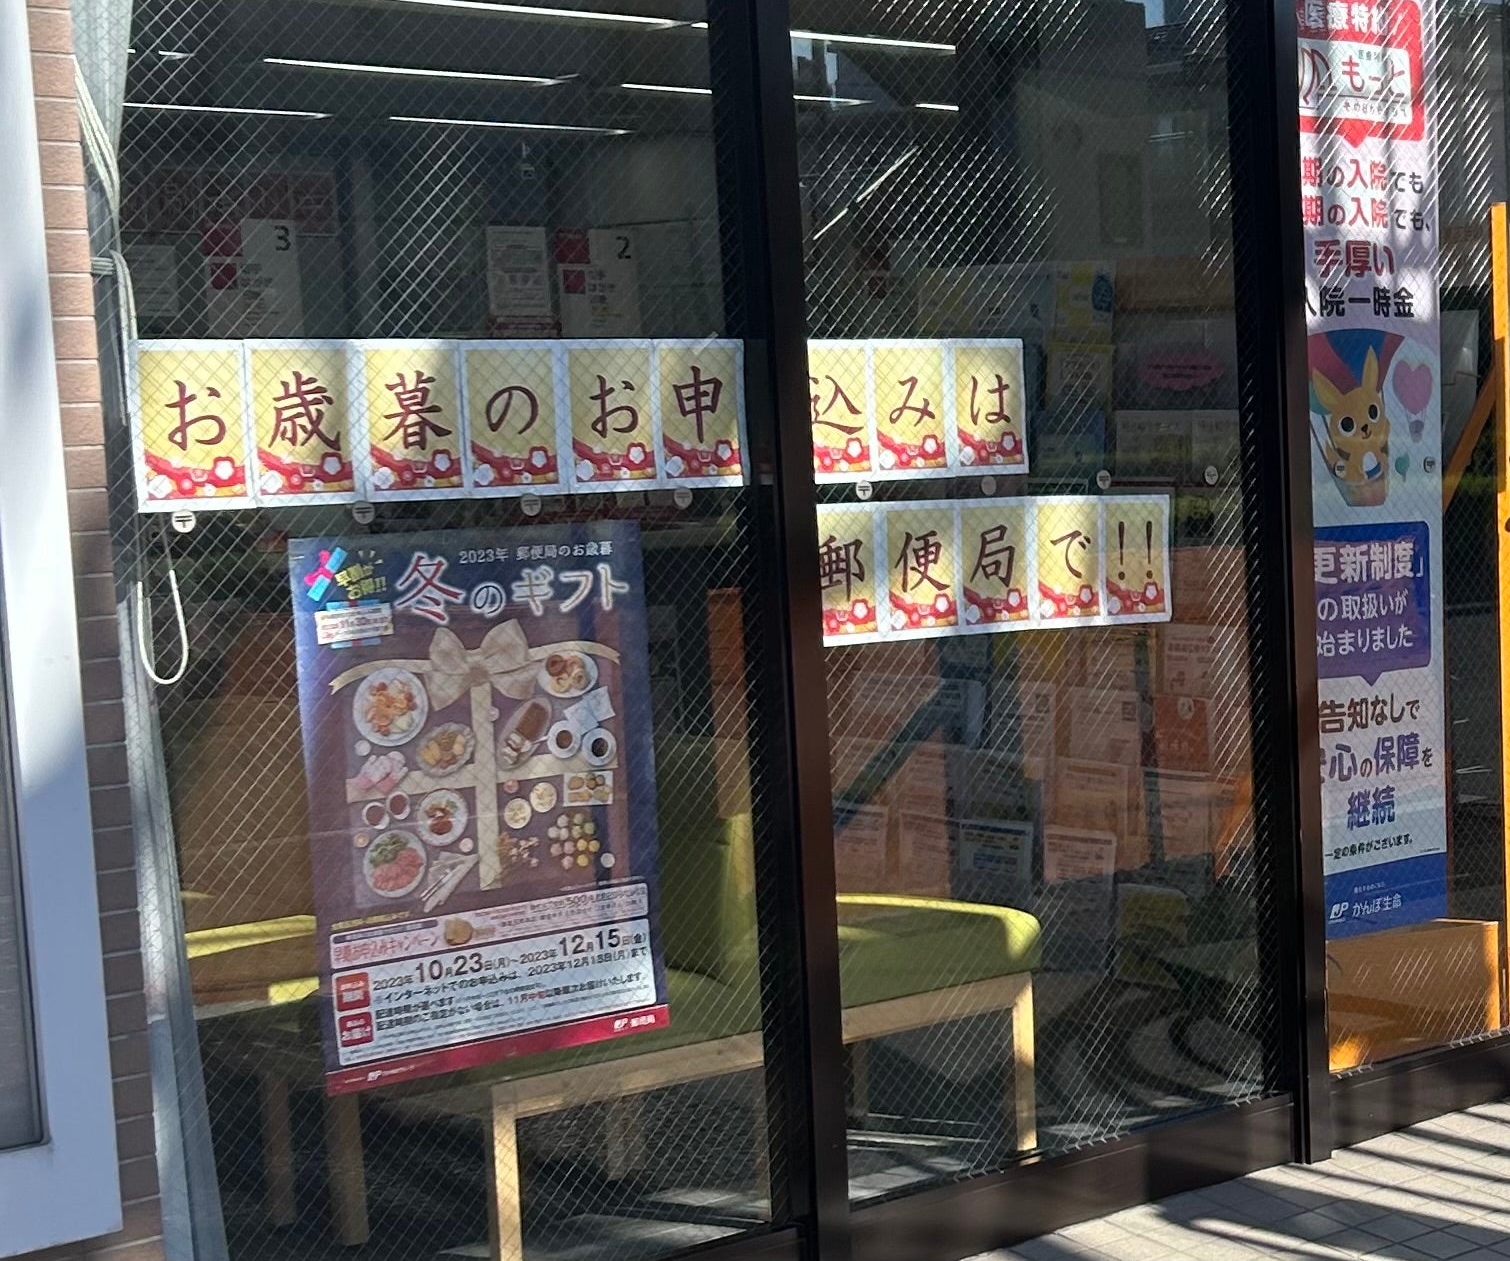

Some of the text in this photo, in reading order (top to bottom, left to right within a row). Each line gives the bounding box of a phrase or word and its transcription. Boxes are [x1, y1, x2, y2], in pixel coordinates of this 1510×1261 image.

[274, 224, 292, 252] 3
[616, 235, 632, 260] 2
[1313, 238, 1396, 278] 手厚い
[459, 540, 615, 566] 2023年 郵便局のお歳暮
[395, 550, 630, 626] 冬のギフト
[1316, 588, 1409, 621] の取扱いが
[1316, 623, 1415, 657] 始まりました
[1319, 692, 1421, 734] 告知なしで
[1347, 785, 1396, 831] 継続
[1352, 892, 1403, 917] かんぽ生命
